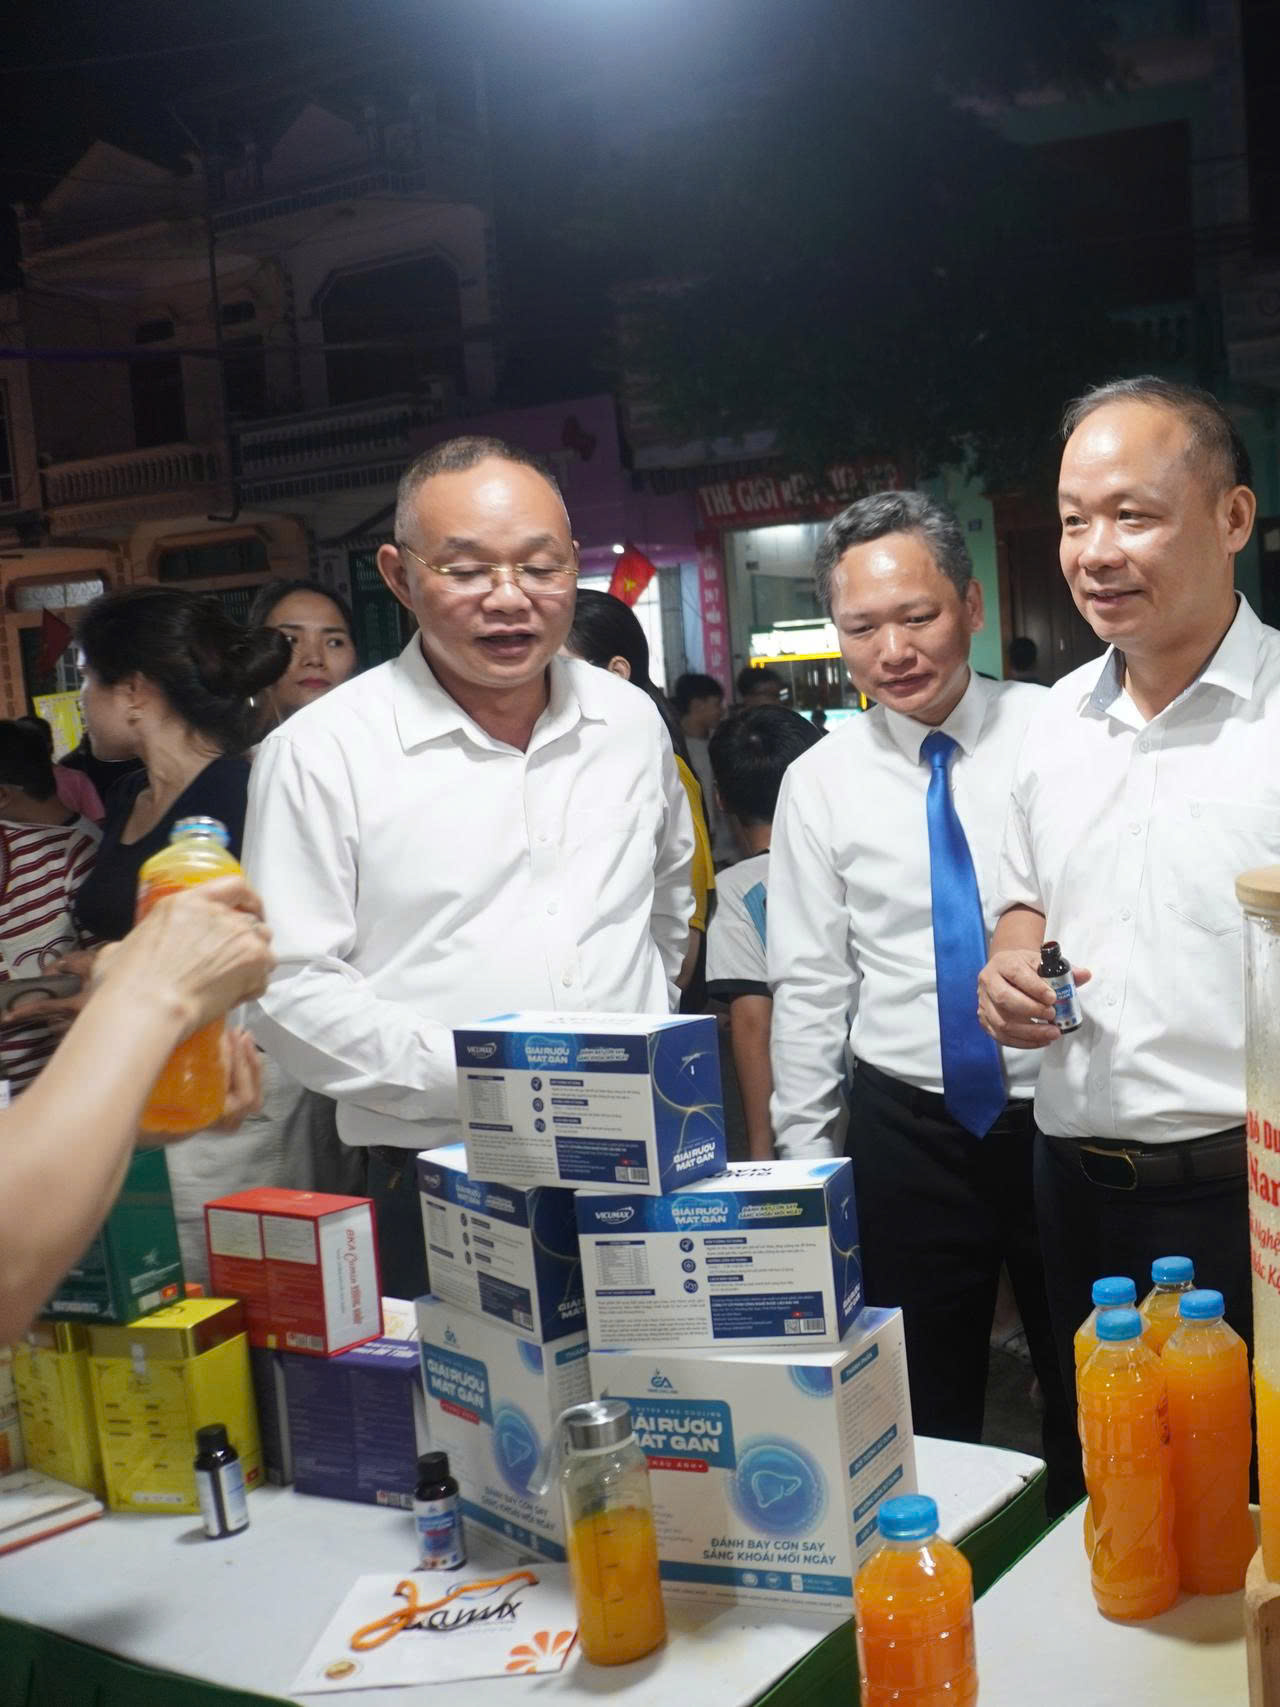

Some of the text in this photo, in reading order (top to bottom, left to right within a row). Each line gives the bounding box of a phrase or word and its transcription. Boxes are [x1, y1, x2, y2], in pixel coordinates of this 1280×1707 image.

[670, 1435, 721, 1453] GAN
[711, 1536, 744, 1549] ĐÁNH
[747, 1539, 771, 1550] BAY
[801, 1541, 826, 1553] SAY
